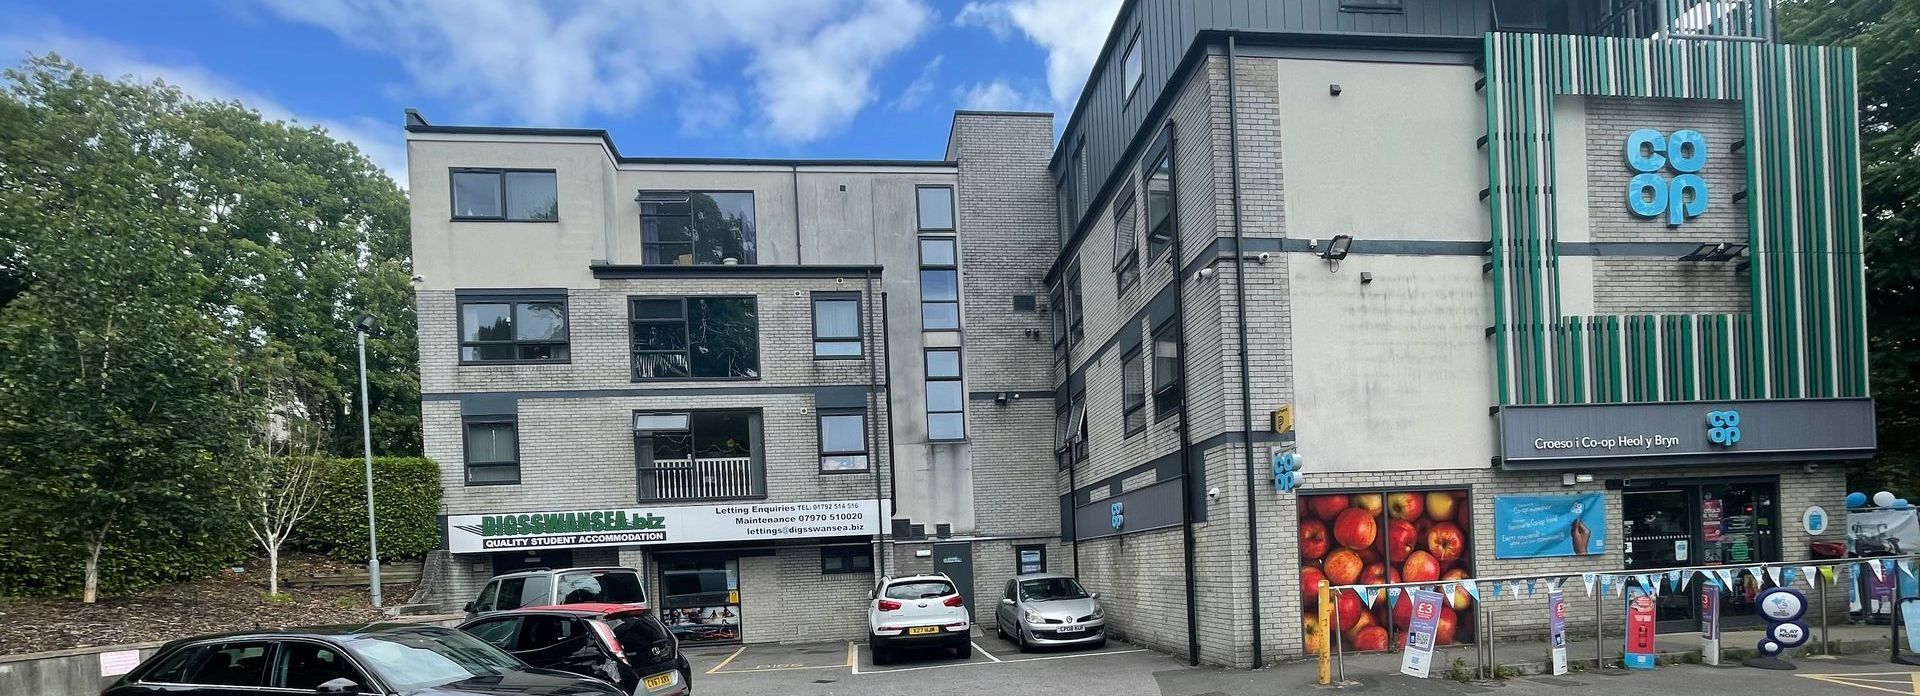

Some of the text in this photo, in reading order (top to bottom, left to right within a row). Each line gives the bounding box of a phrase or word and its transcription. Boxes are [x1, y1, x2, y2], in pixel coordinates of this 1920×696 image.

[1534, 434, 1680, 450] Croeso i Co-op Heol y Bryn
[715, 506, 749, 515] Letting
[752, 504, 796, 514] Enquiries
[735, 513, 863, 525] Maintenance 07970 510020
[747, 524, 864, 536] lettings@digsswansea.biz
[485, 532, 664, 548] QUALITY STUDENT ACCOMMODATION
[1418, 602, 1433, 614] £3
